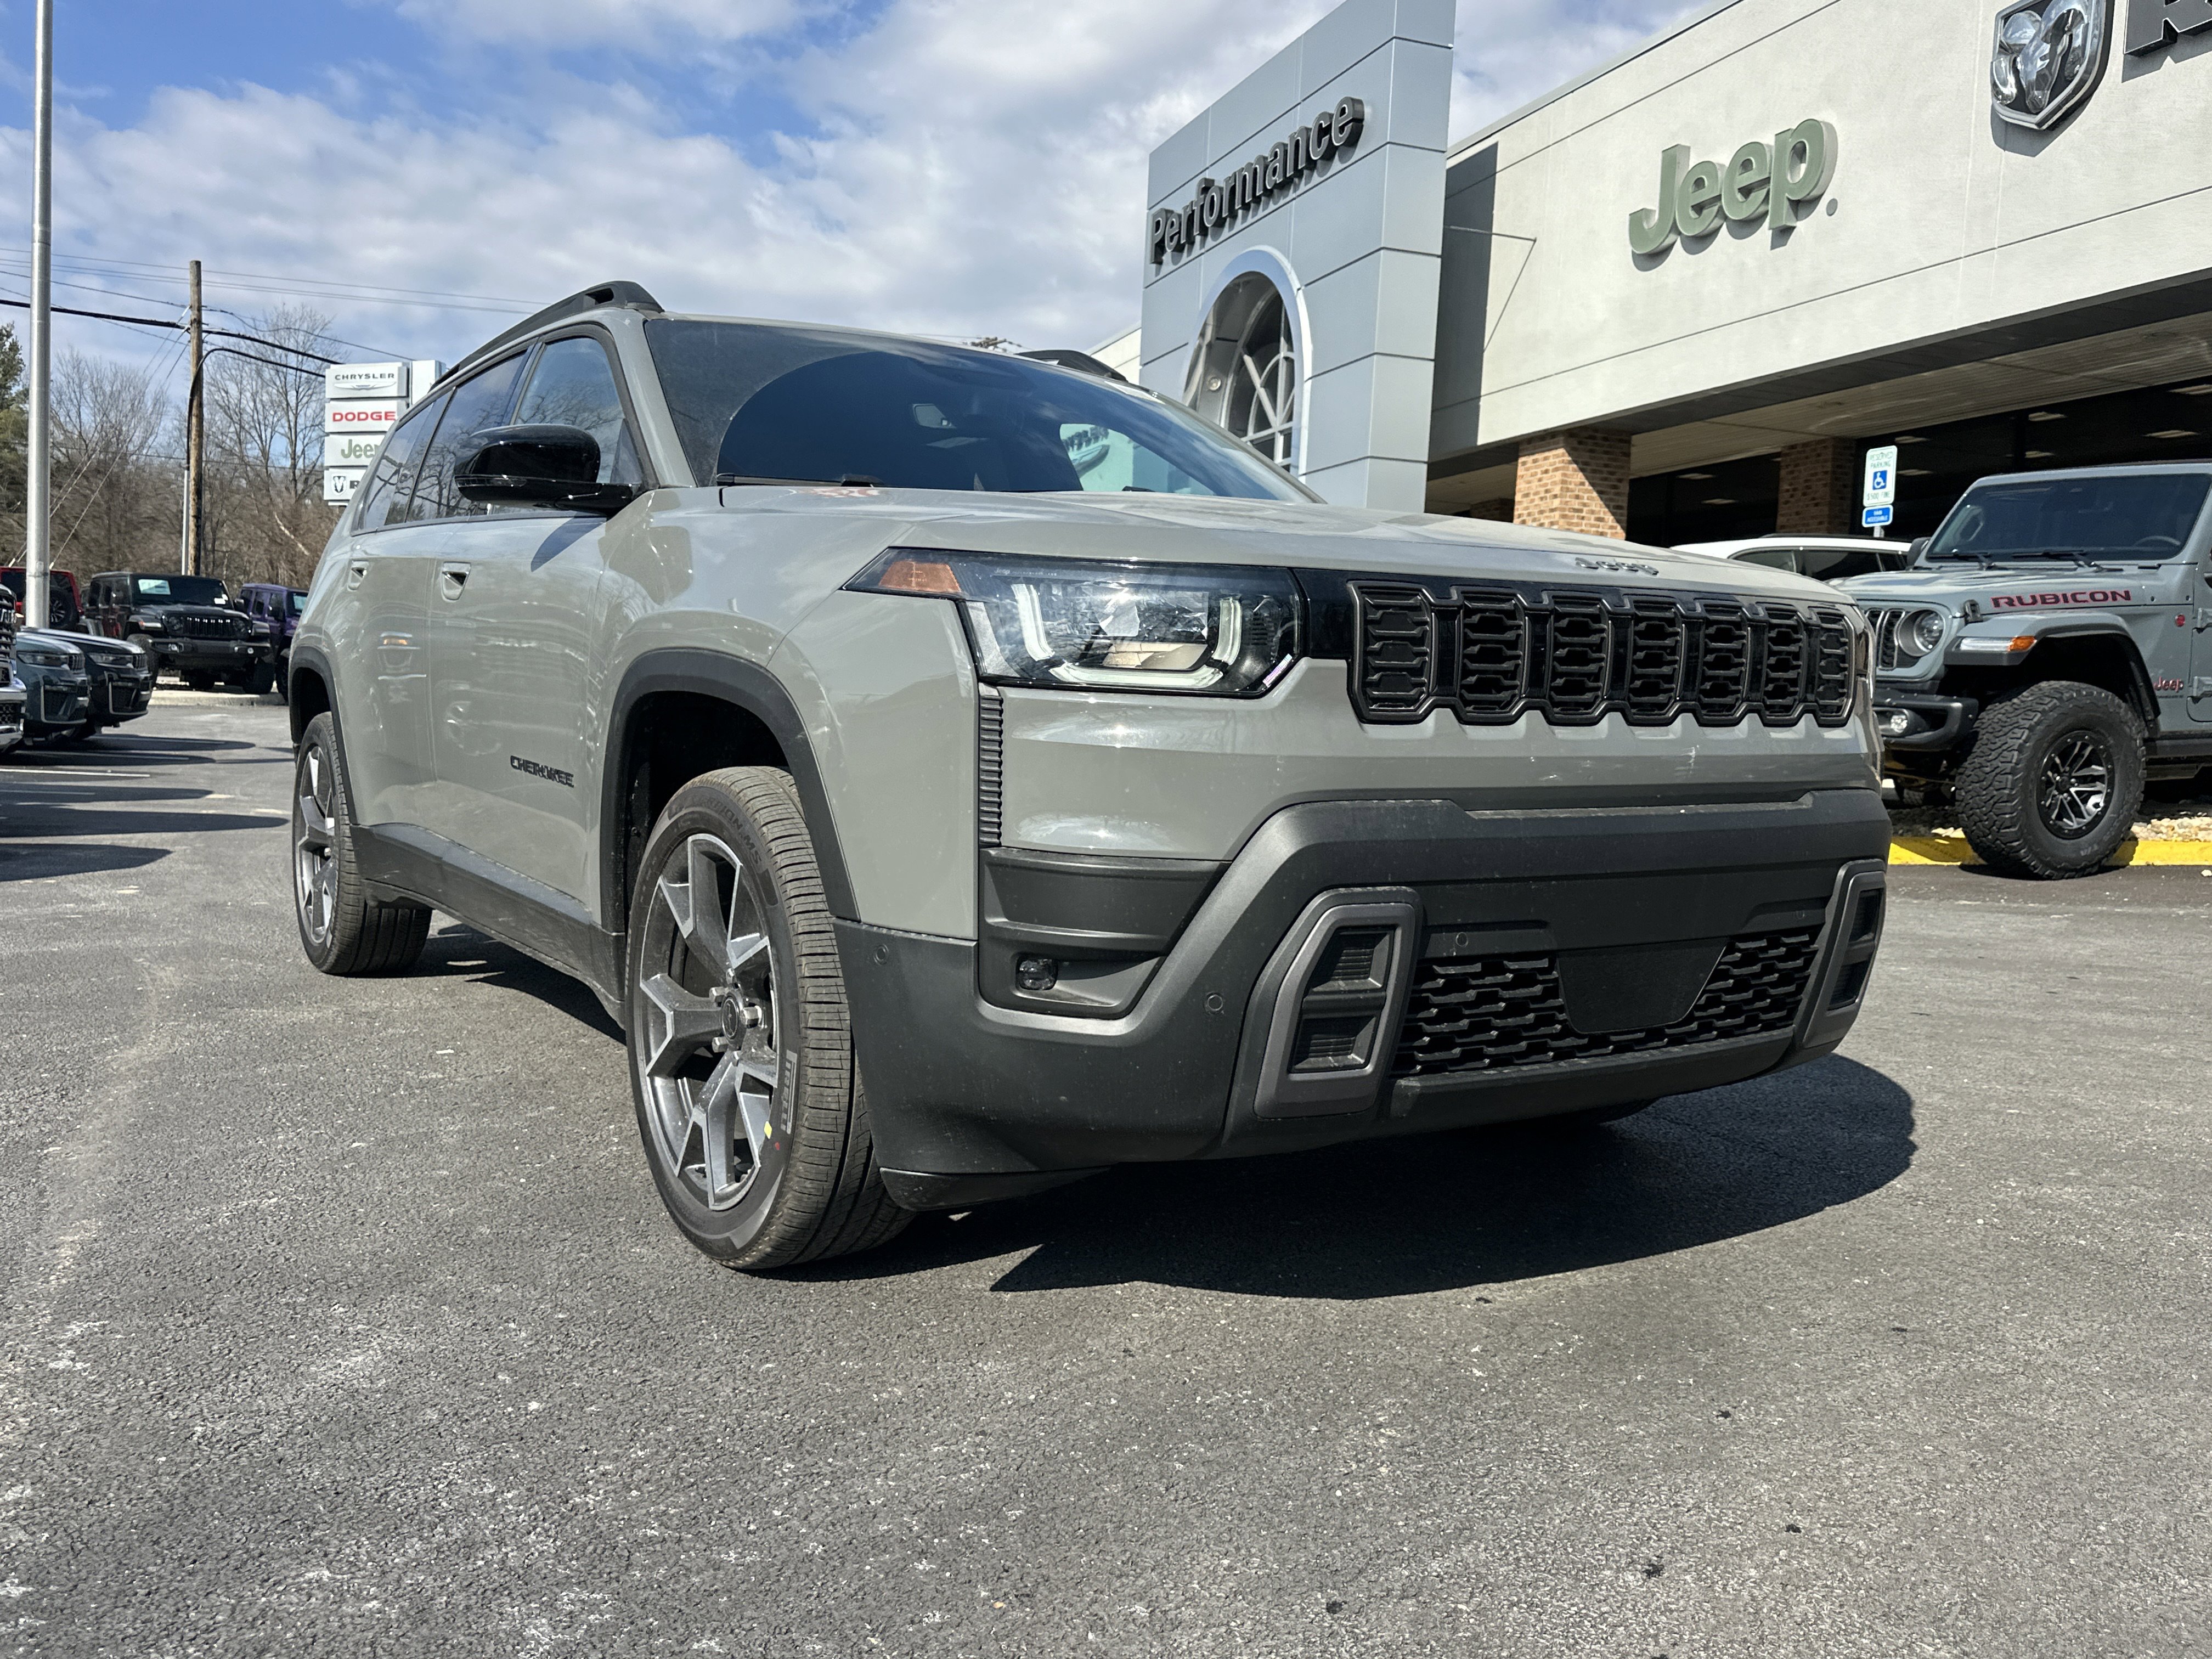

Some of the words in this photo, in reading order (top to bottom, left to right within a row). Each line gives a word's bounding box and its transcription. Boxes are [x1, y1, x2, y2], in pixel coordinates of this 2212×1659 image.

[1149, 95, 1365, 265] Performance
[1628, 119, 1839, 255] Jeep
[335, 373, 394, 381] CHRYSLER
[332, 411, 396, 422] DODGE
[341, 438, 381, 459] Jee
[1990, 590, 2132, 608] RUBICON
[2153, 676, 2184, 693] Jeep
[510, 755, 575, 788] CHEROKEE
